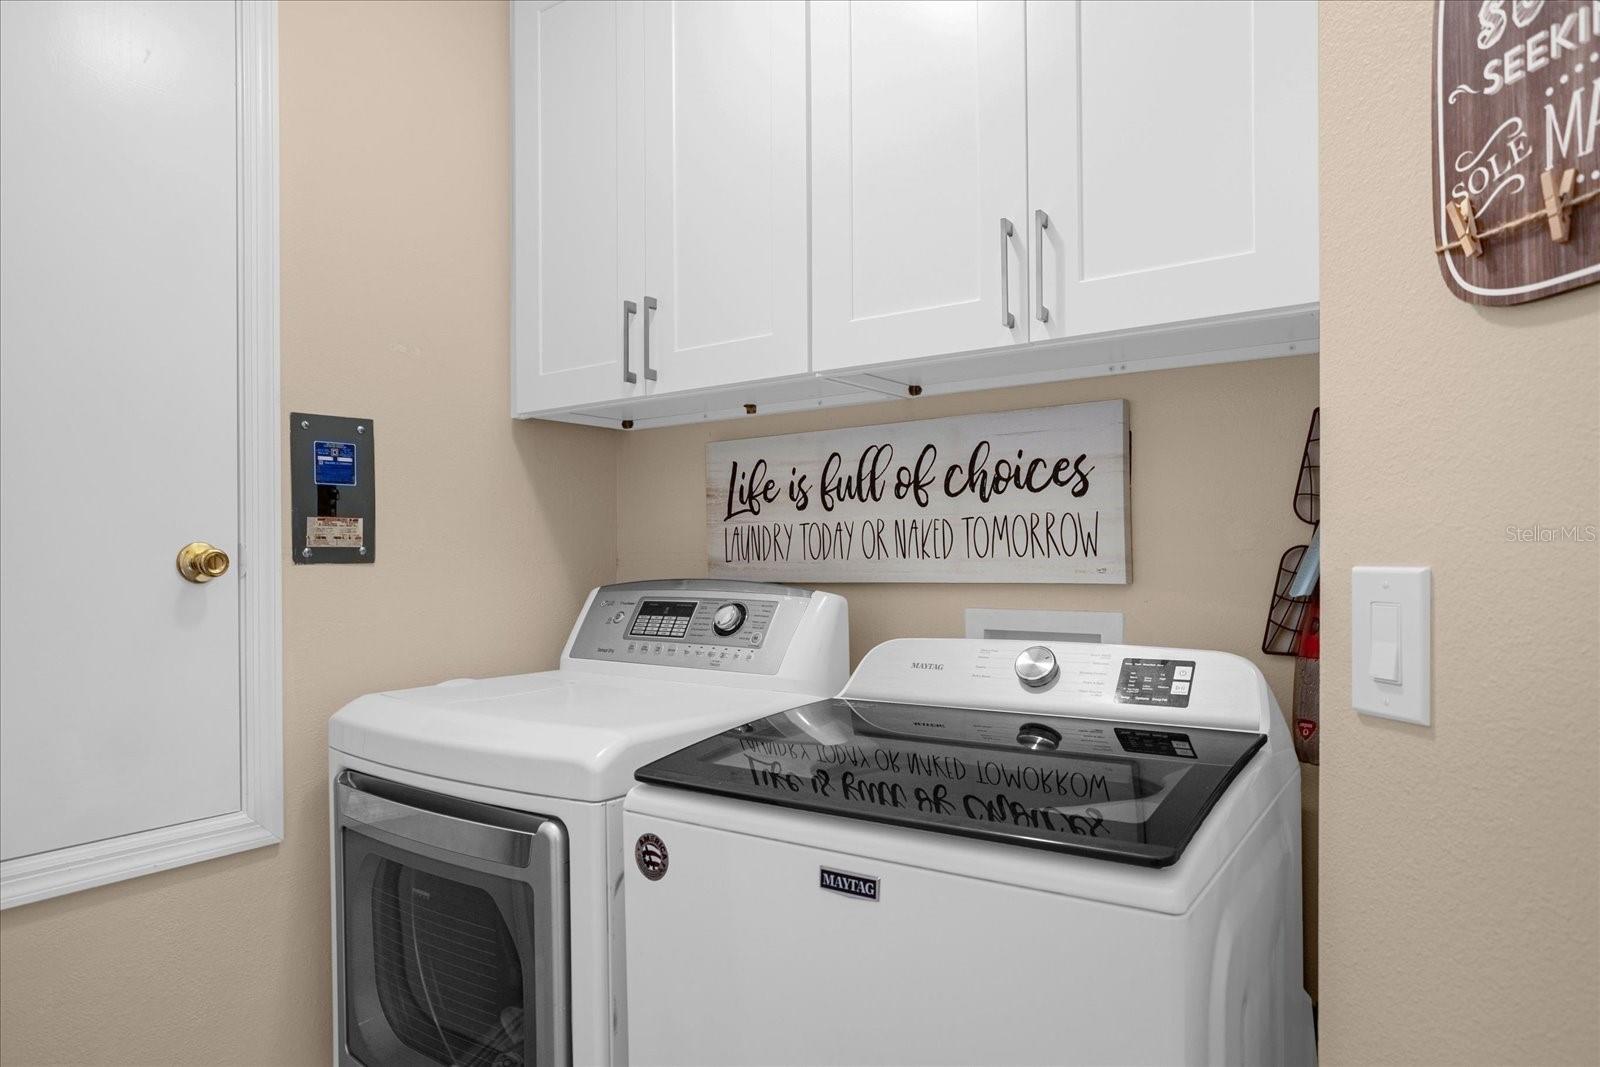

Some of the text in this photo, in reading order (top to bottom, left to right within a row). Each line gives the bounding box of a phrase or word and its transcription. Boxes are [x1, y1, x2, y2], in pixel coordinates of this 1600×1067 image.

[1452, 131, 1533, 207] SOLE
[724, 441, 1095, 521] Life is full of choices
[724, 511, 1098, 563] LAUNDRY TODAY OR NAKED TOMORROW
[910, 662, 945, 671] MAYTAG
[822, 872, 875, 896] MAYTAG
